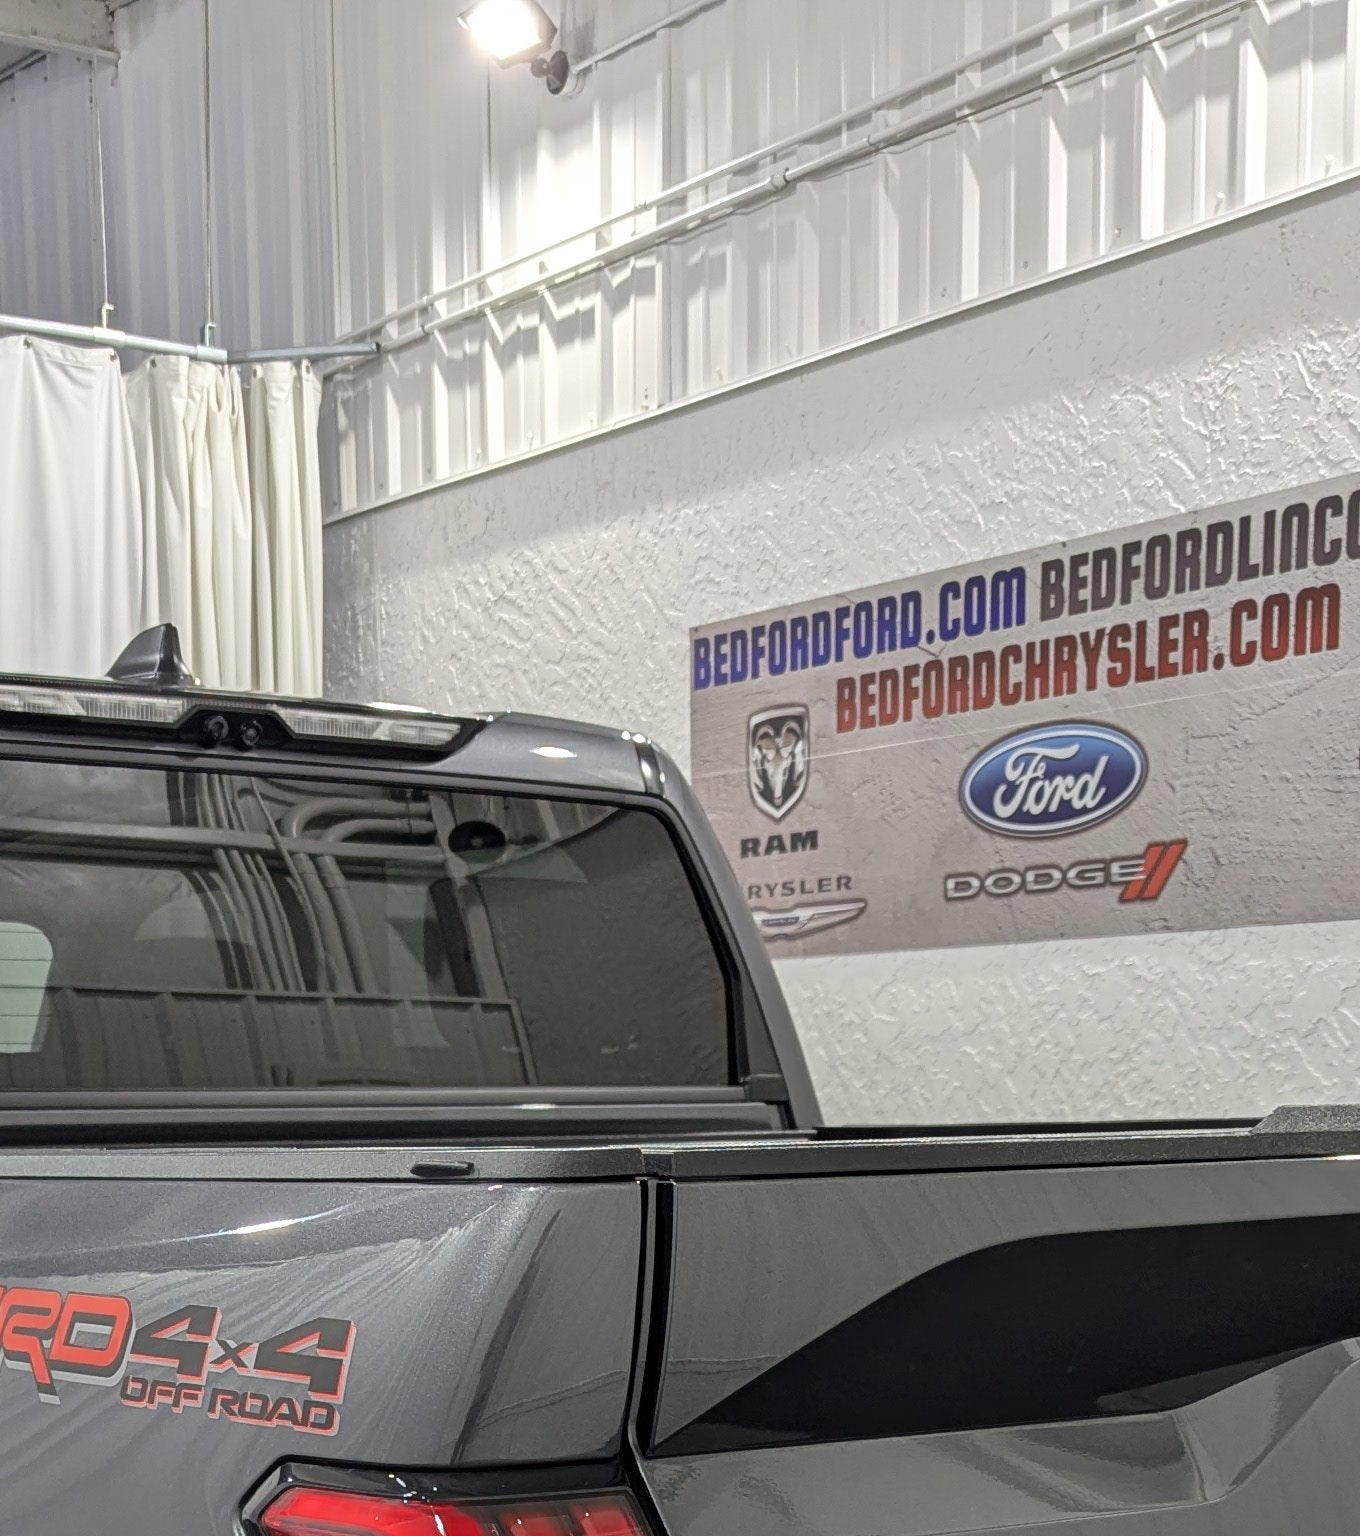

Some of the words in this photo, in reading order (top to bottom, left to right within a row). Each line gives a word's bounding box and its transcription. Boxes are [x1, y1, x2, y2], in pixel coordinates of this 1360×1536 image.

[693, 565, 1027, 691] BEDFORDFORD.COM
[836, 582, 1341, 734] BEDFORDCHRYSLER.COM
[993, 744, 1110, 819] Ford
[741, 829, 819, 859] RAM
[747, 875, 853, 900] RYSLER
[944, 855, 1148, 900] DODGE
[119, 1375, 207, 1414] OFF
[207, 1387, 341, 1438] ROAD
